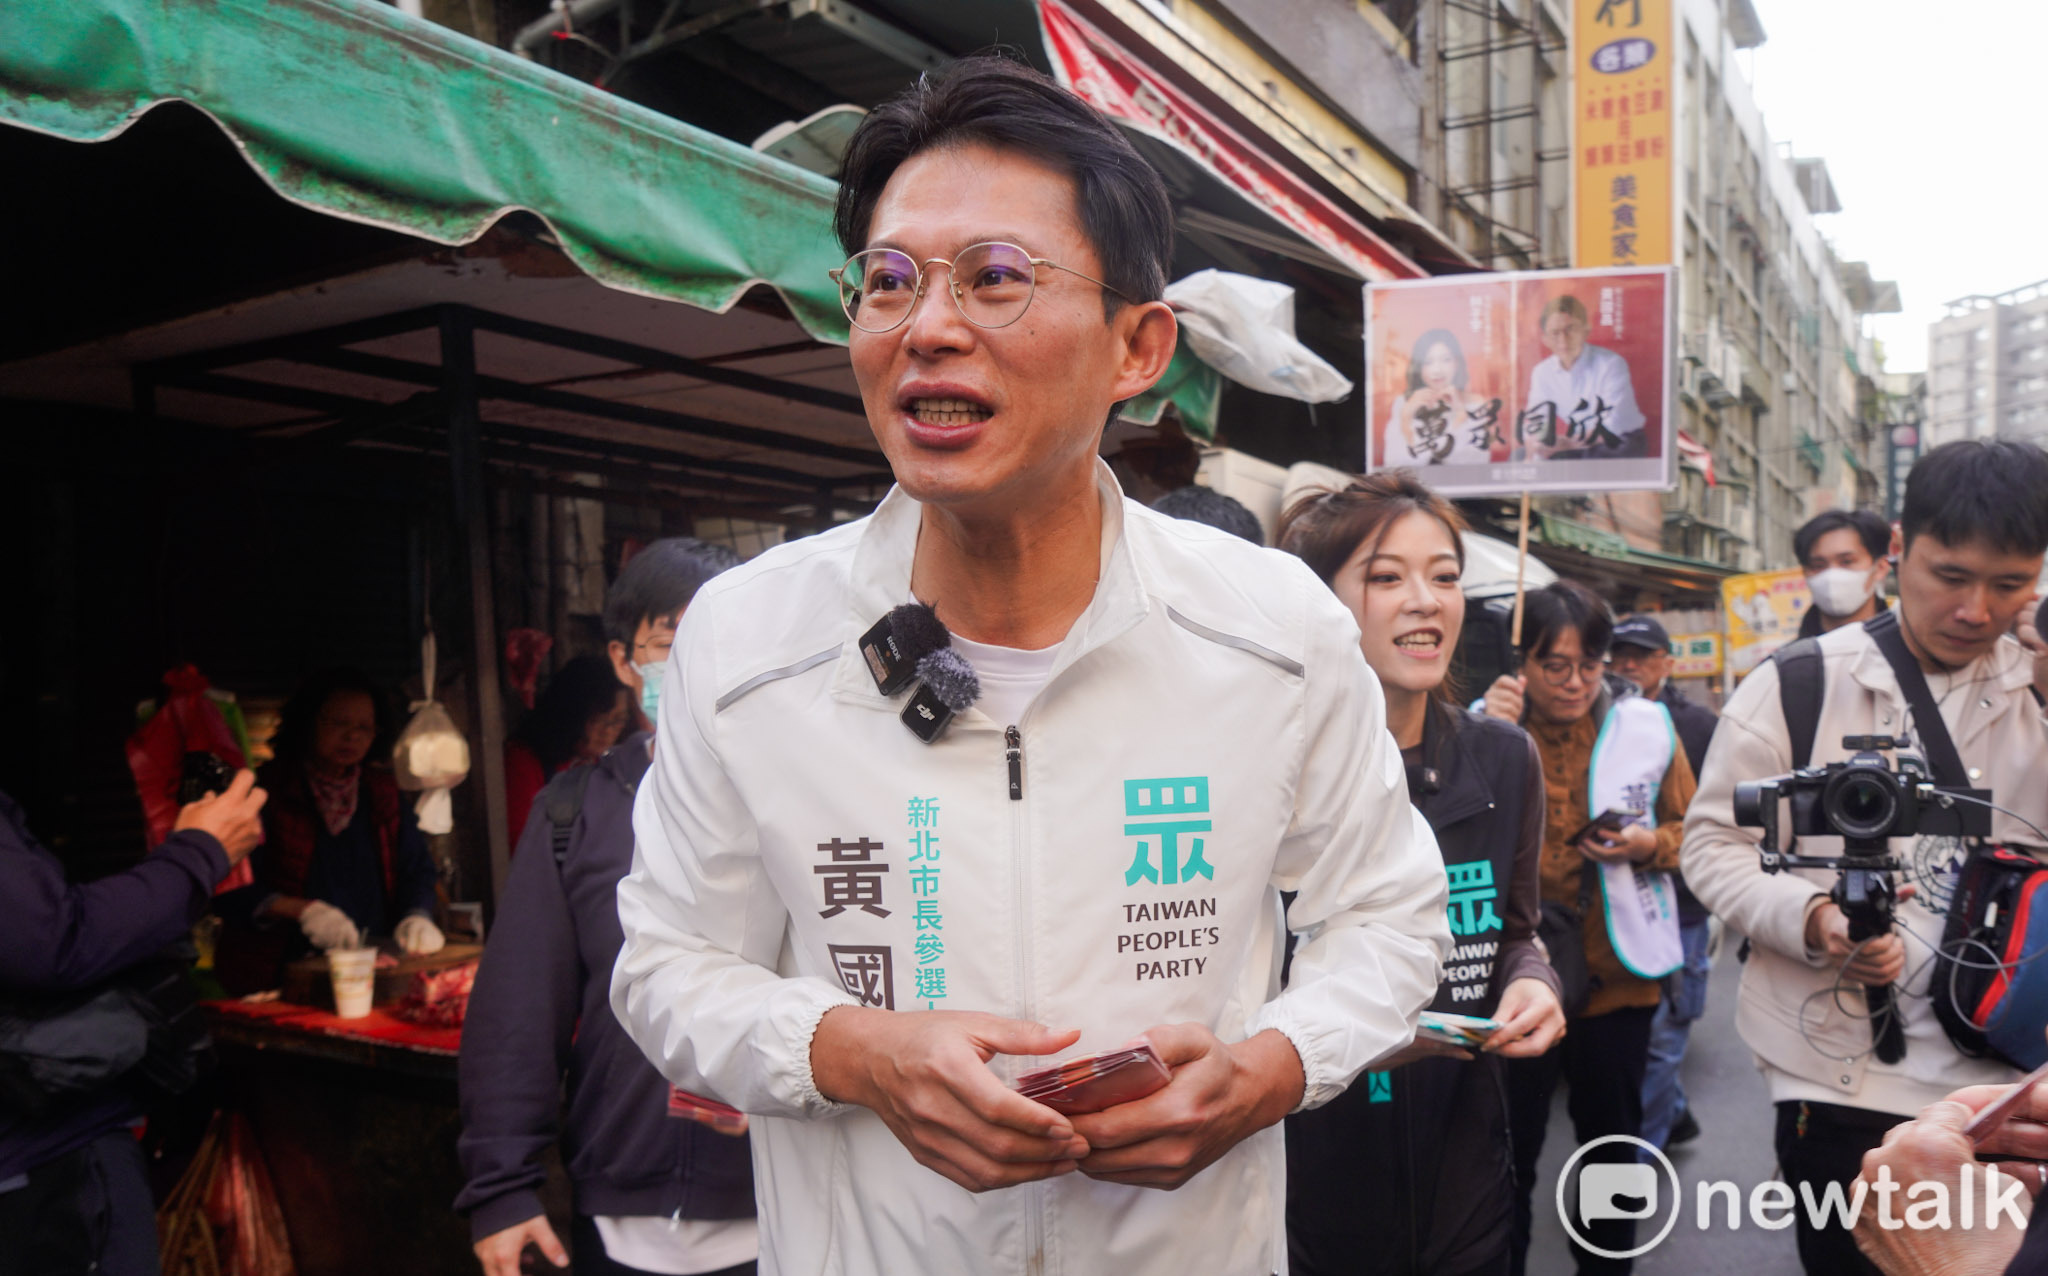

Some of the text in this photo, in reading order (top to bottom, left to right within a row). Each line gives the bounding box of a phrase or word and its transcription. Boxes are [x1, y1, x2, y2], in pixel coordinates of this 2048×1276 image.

[1611, 175, 1638, 266] 美食家
[1122, 897, 1217, 923] TAIWAN
[1117, 926, 1220, 953] PEOPLE'S
[1136, 956, 1208, 981] PARTY
